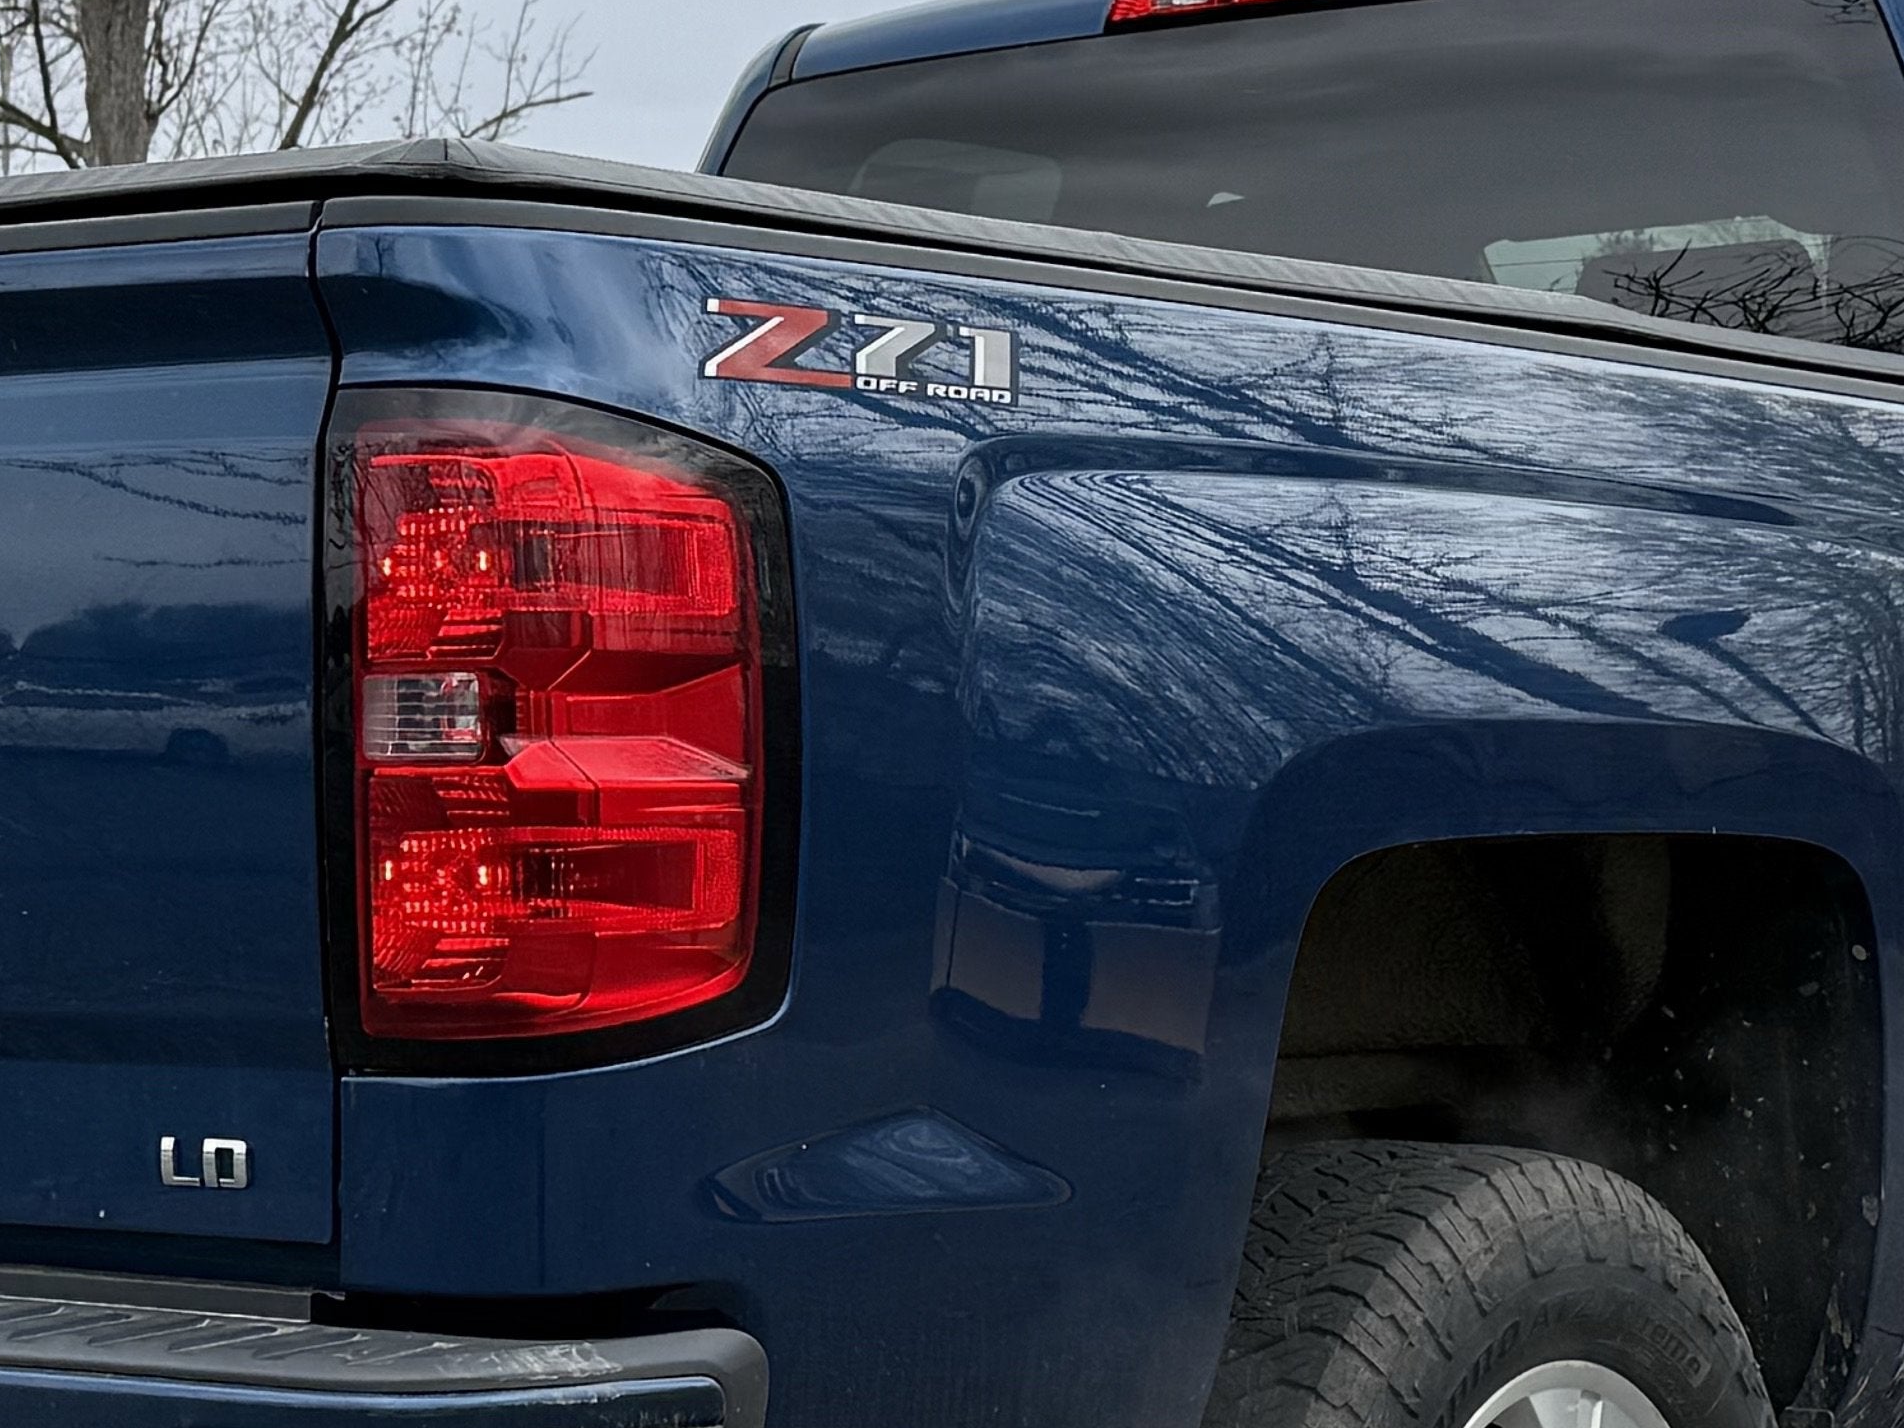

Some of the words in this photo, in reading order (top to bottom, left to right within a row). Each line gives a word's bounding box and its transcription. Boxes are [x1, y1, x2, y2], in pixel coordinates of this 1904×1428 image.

[702, 297, 1016, 392] Z71
[855, 375, 920, 396] OFF
[926, 383, 1013, 405] ROAD
[160, 1135, 248, 1190] LD
